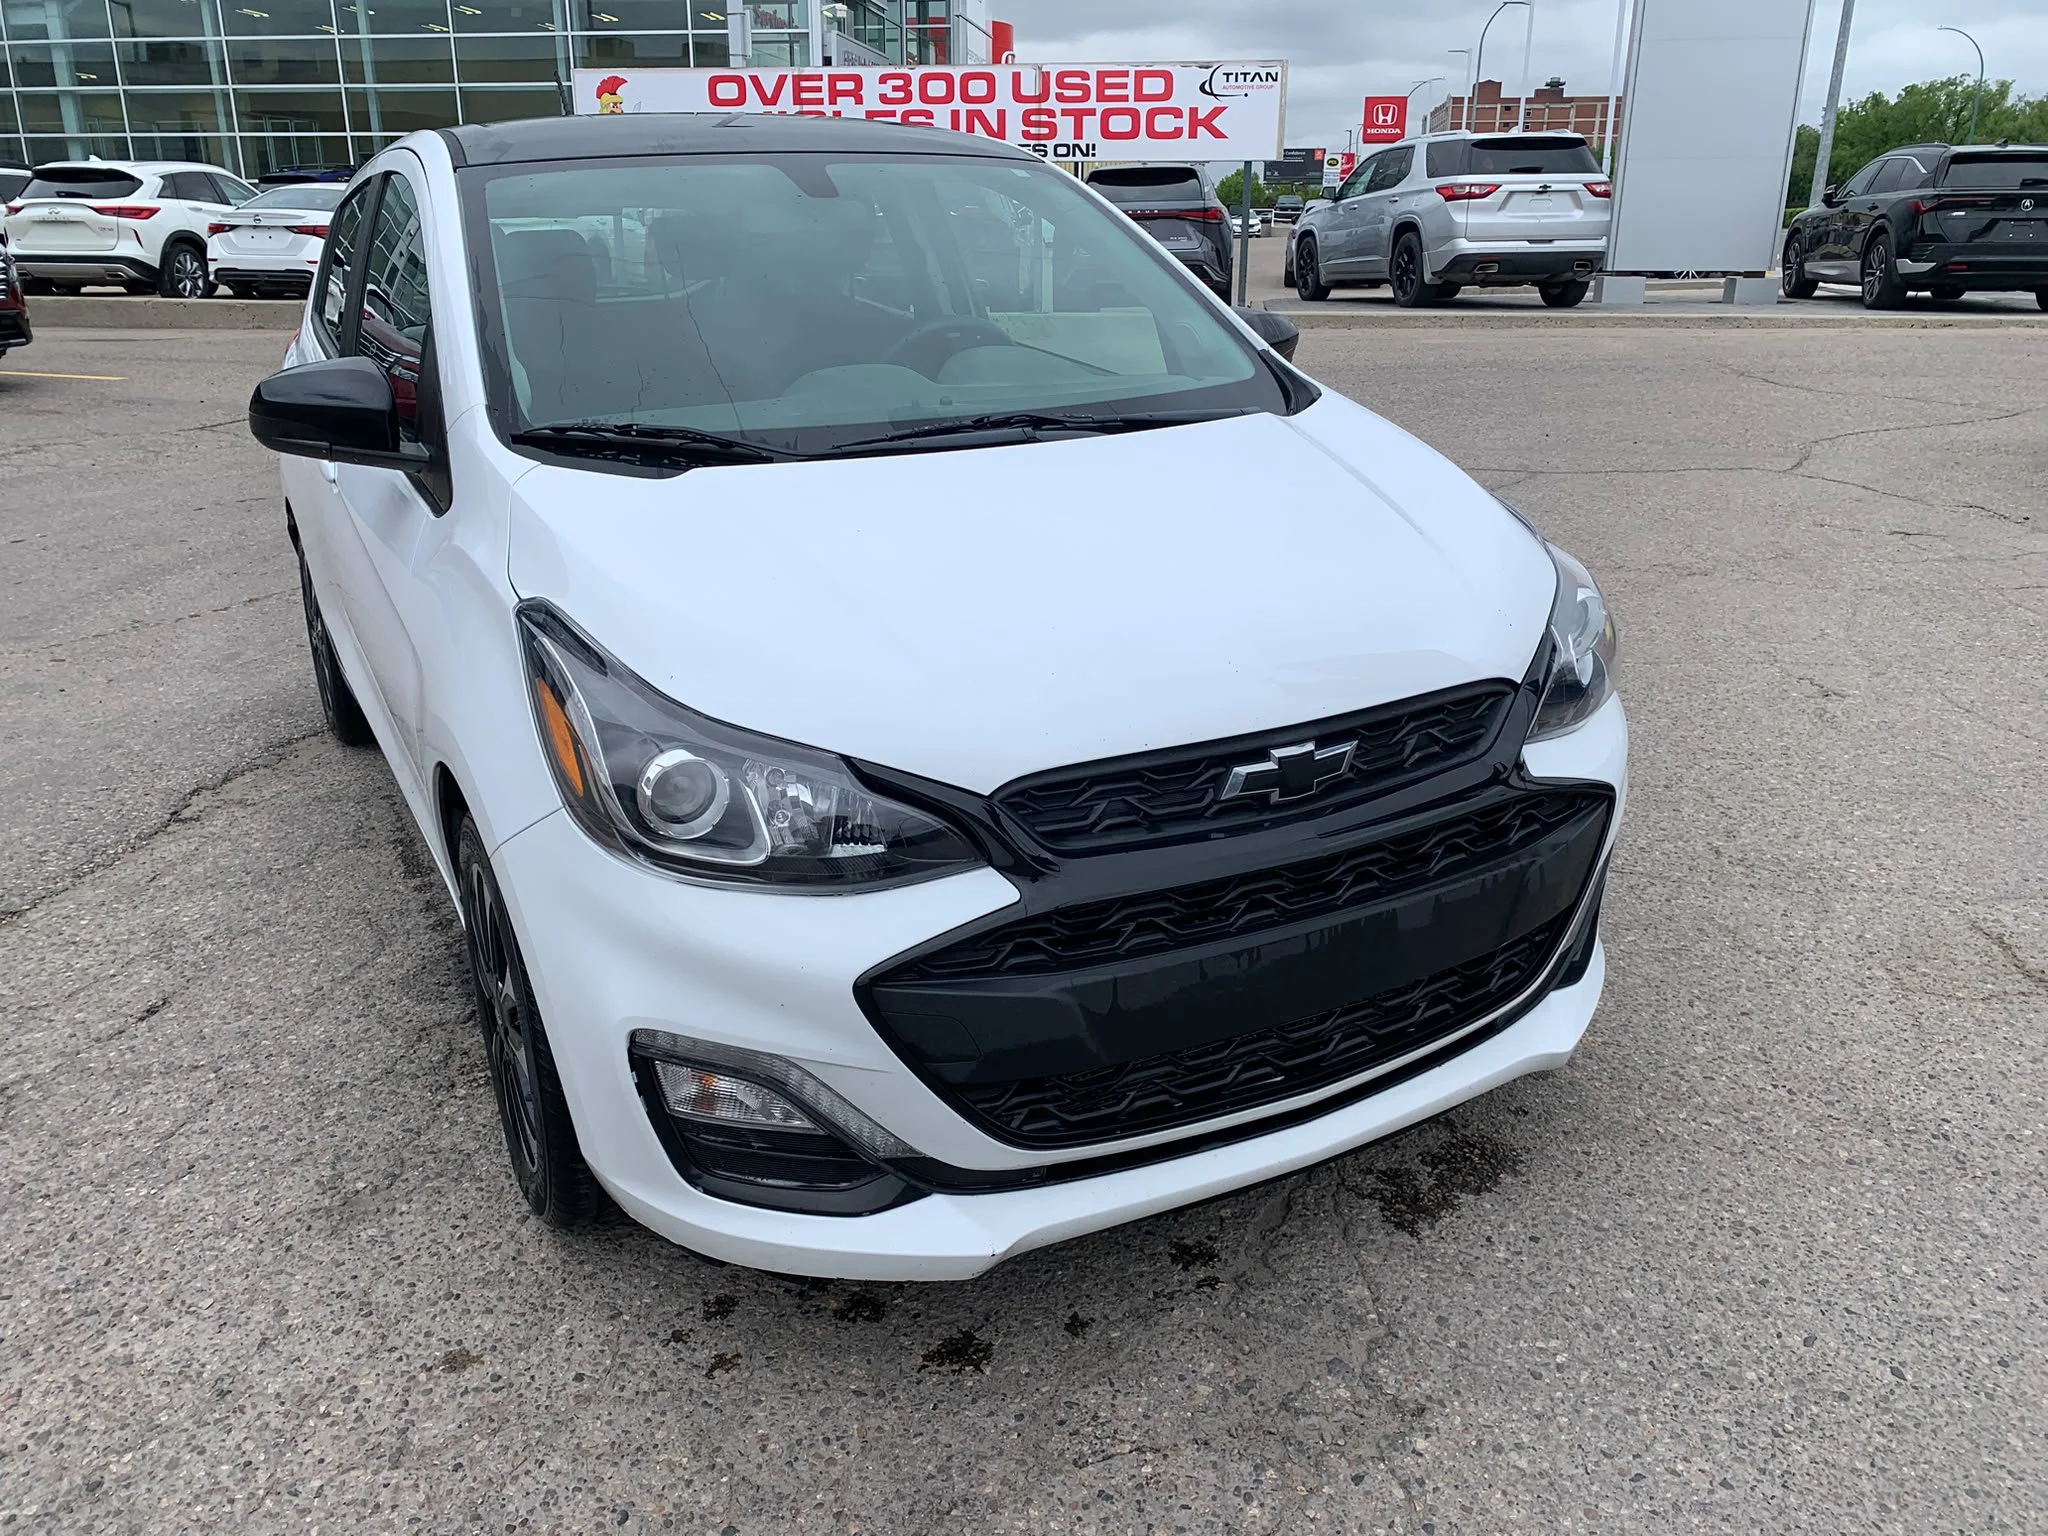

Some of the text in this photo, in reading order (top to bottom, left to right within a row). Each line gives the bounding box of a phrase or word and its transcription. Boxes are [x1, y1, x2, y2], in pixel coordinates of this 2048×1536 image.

[708, 69, 1174, 107] OVER 300 USED
[1222, 72, 1279, 83] TITAN
[950, 108, 1006, 141] IN
[1021, 105, 1229, 141] STOCK
[1053, 143, 1096, 158] ON!
